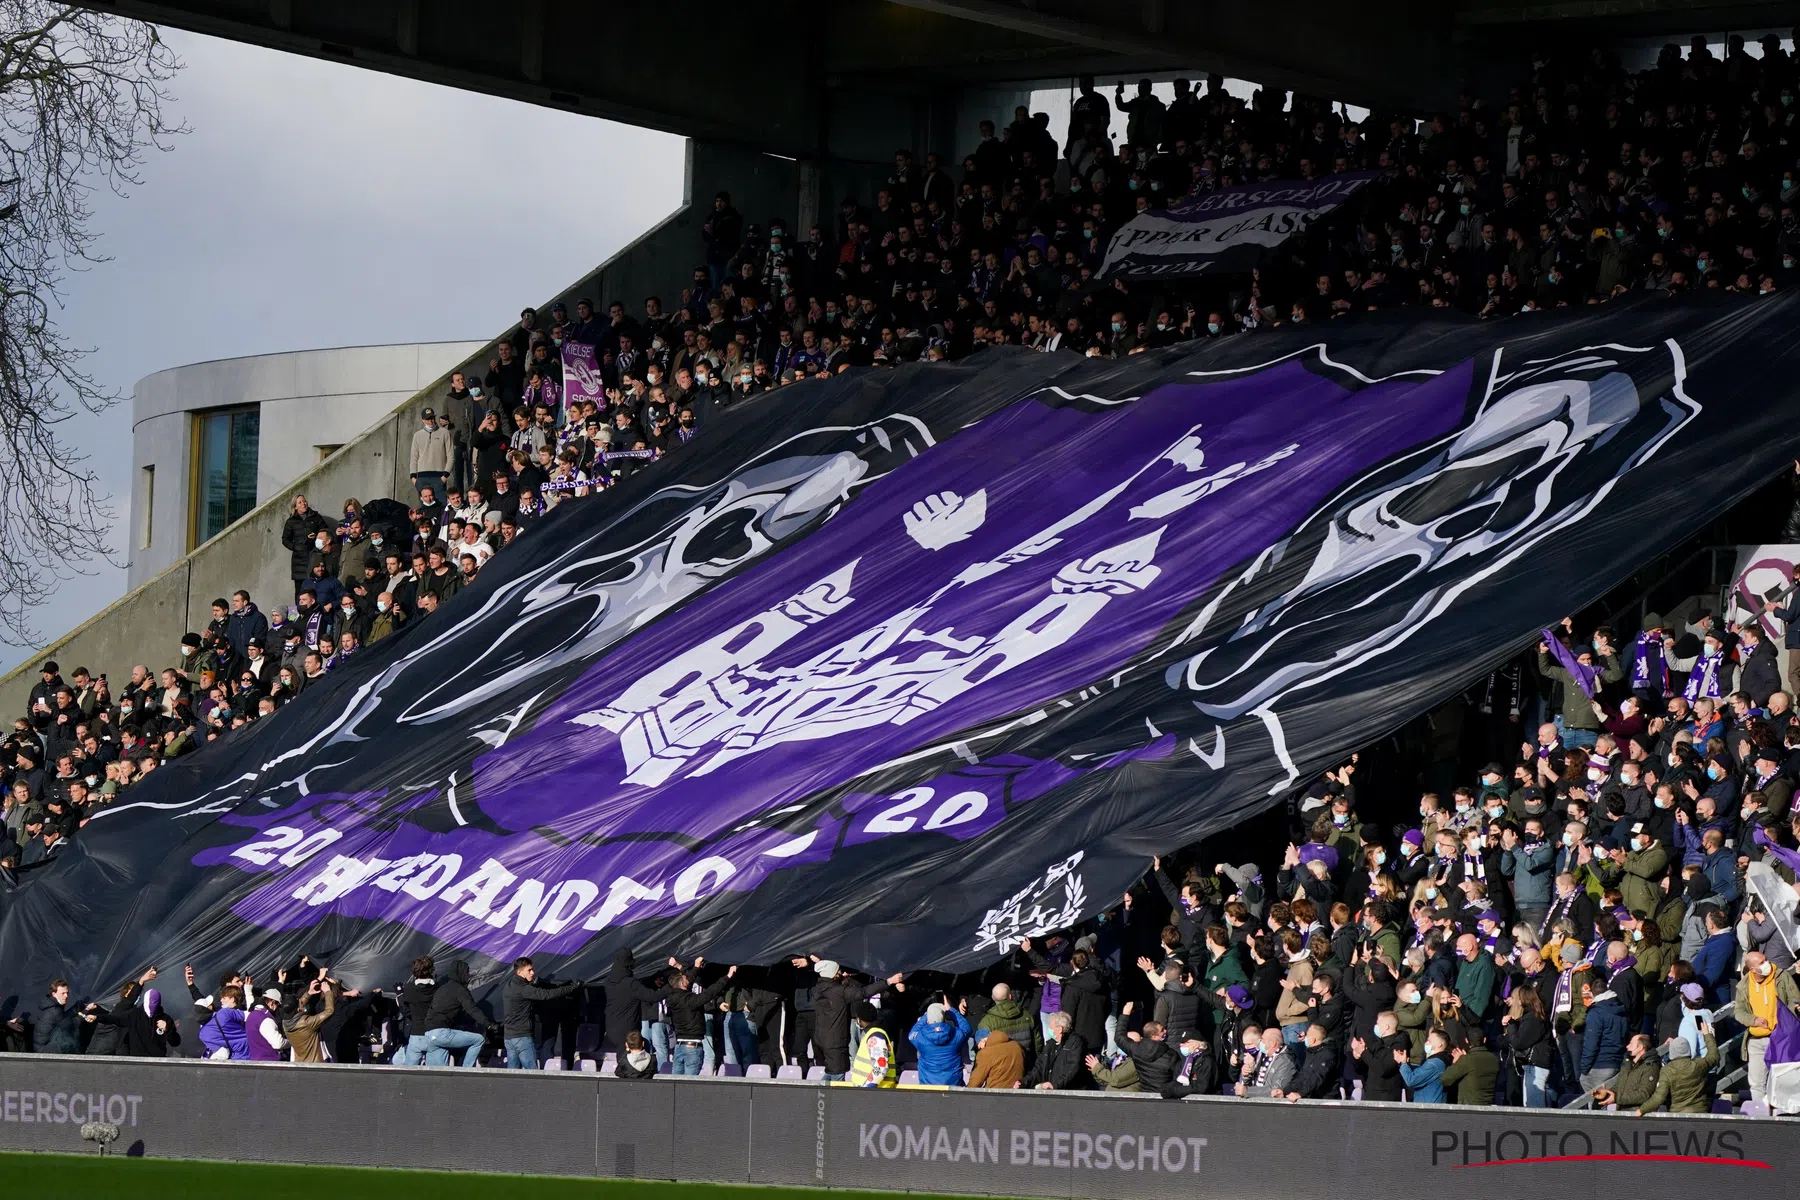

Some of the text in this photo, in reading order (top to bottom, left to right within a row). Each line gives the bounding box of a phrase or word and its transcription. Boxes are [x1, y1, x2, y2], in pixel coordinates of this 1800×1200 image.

[1165, 178, 1372, 215] ERSCHOT
[565, 342, 593, 358] KIELSE
[863, 786, 989, 834] 20
[229, 825, 343, 868] 20
[0, 1090, 143, 1128] EERSCHOT
[815, 1090, 826, 1180] BEERSCHOT
[858, 1122, 1208, 1174] KOMAAN BEERSCHOT
